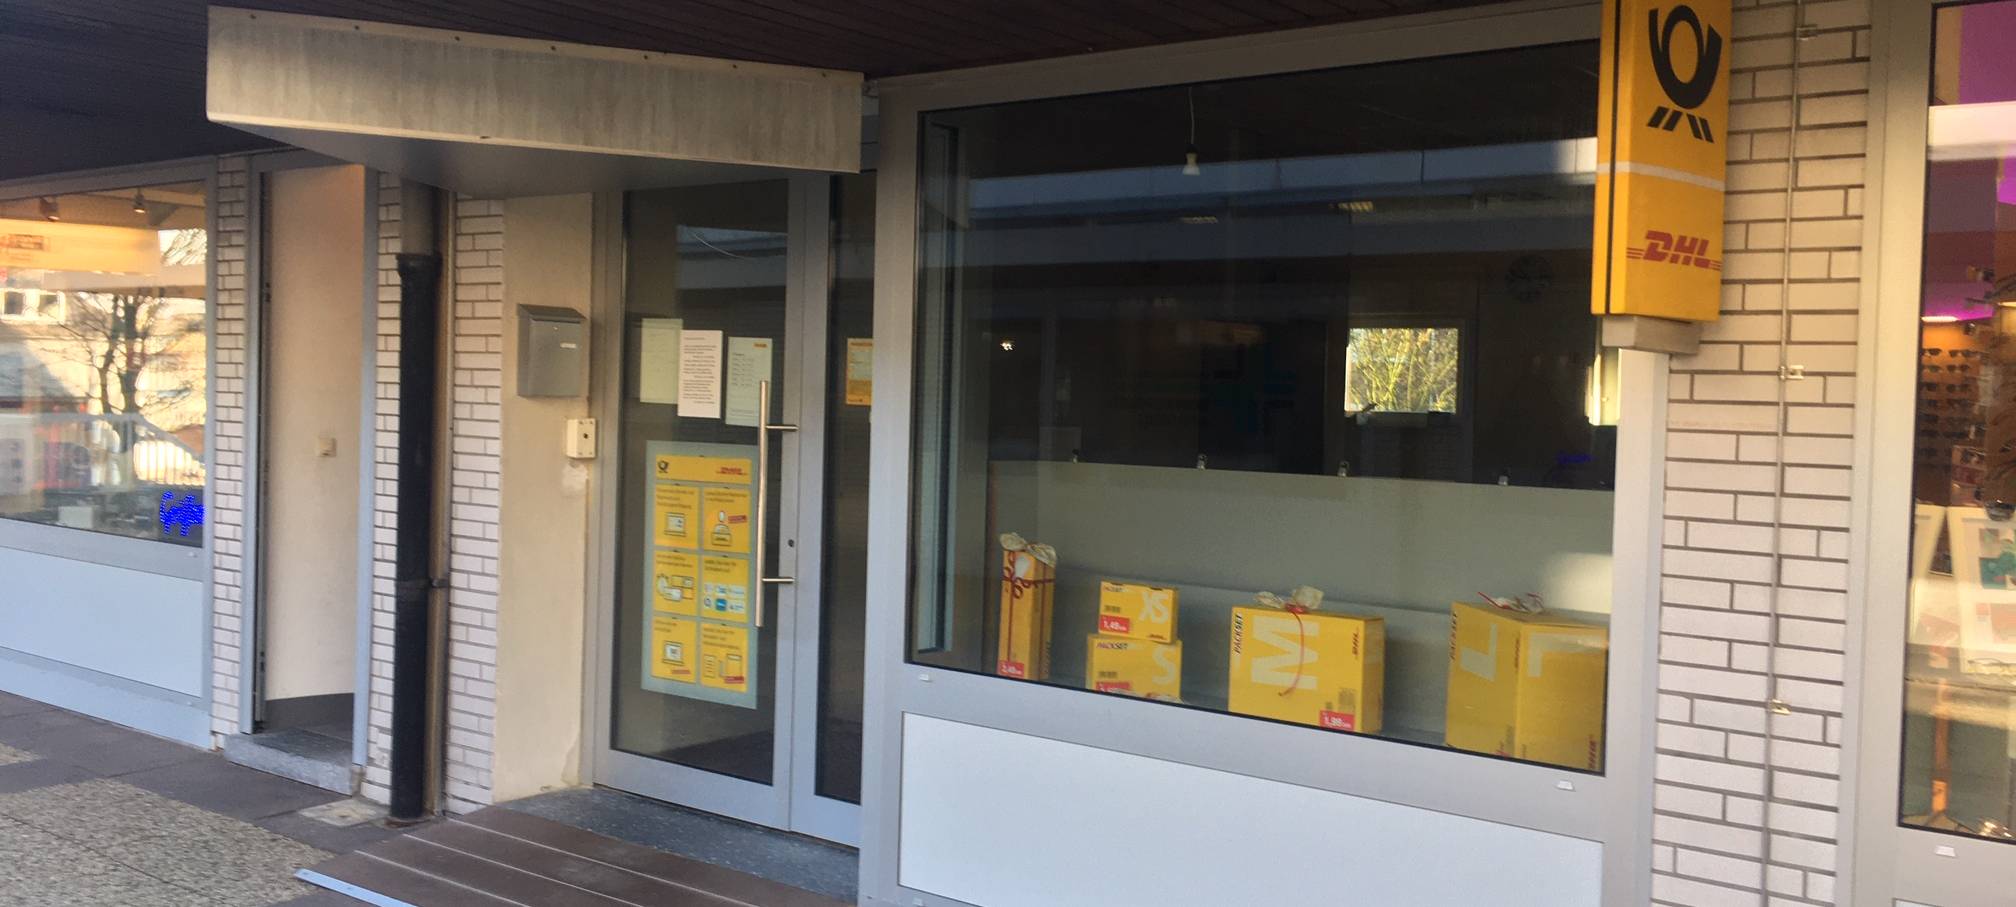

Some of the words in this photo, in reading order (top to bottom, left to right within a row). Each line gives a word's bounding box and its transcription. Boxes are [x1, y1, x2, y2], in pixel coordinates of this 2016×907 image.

[1640, 229, 1714, 269] DHL
[1139, 590, 1170, 625] XS
[1233, 613, 1244, 656] PACKSET
[1251, 615, 1320, 690] M
[1461, 623, 1498, 683] L
[1151, 644, 1177, 685] S
